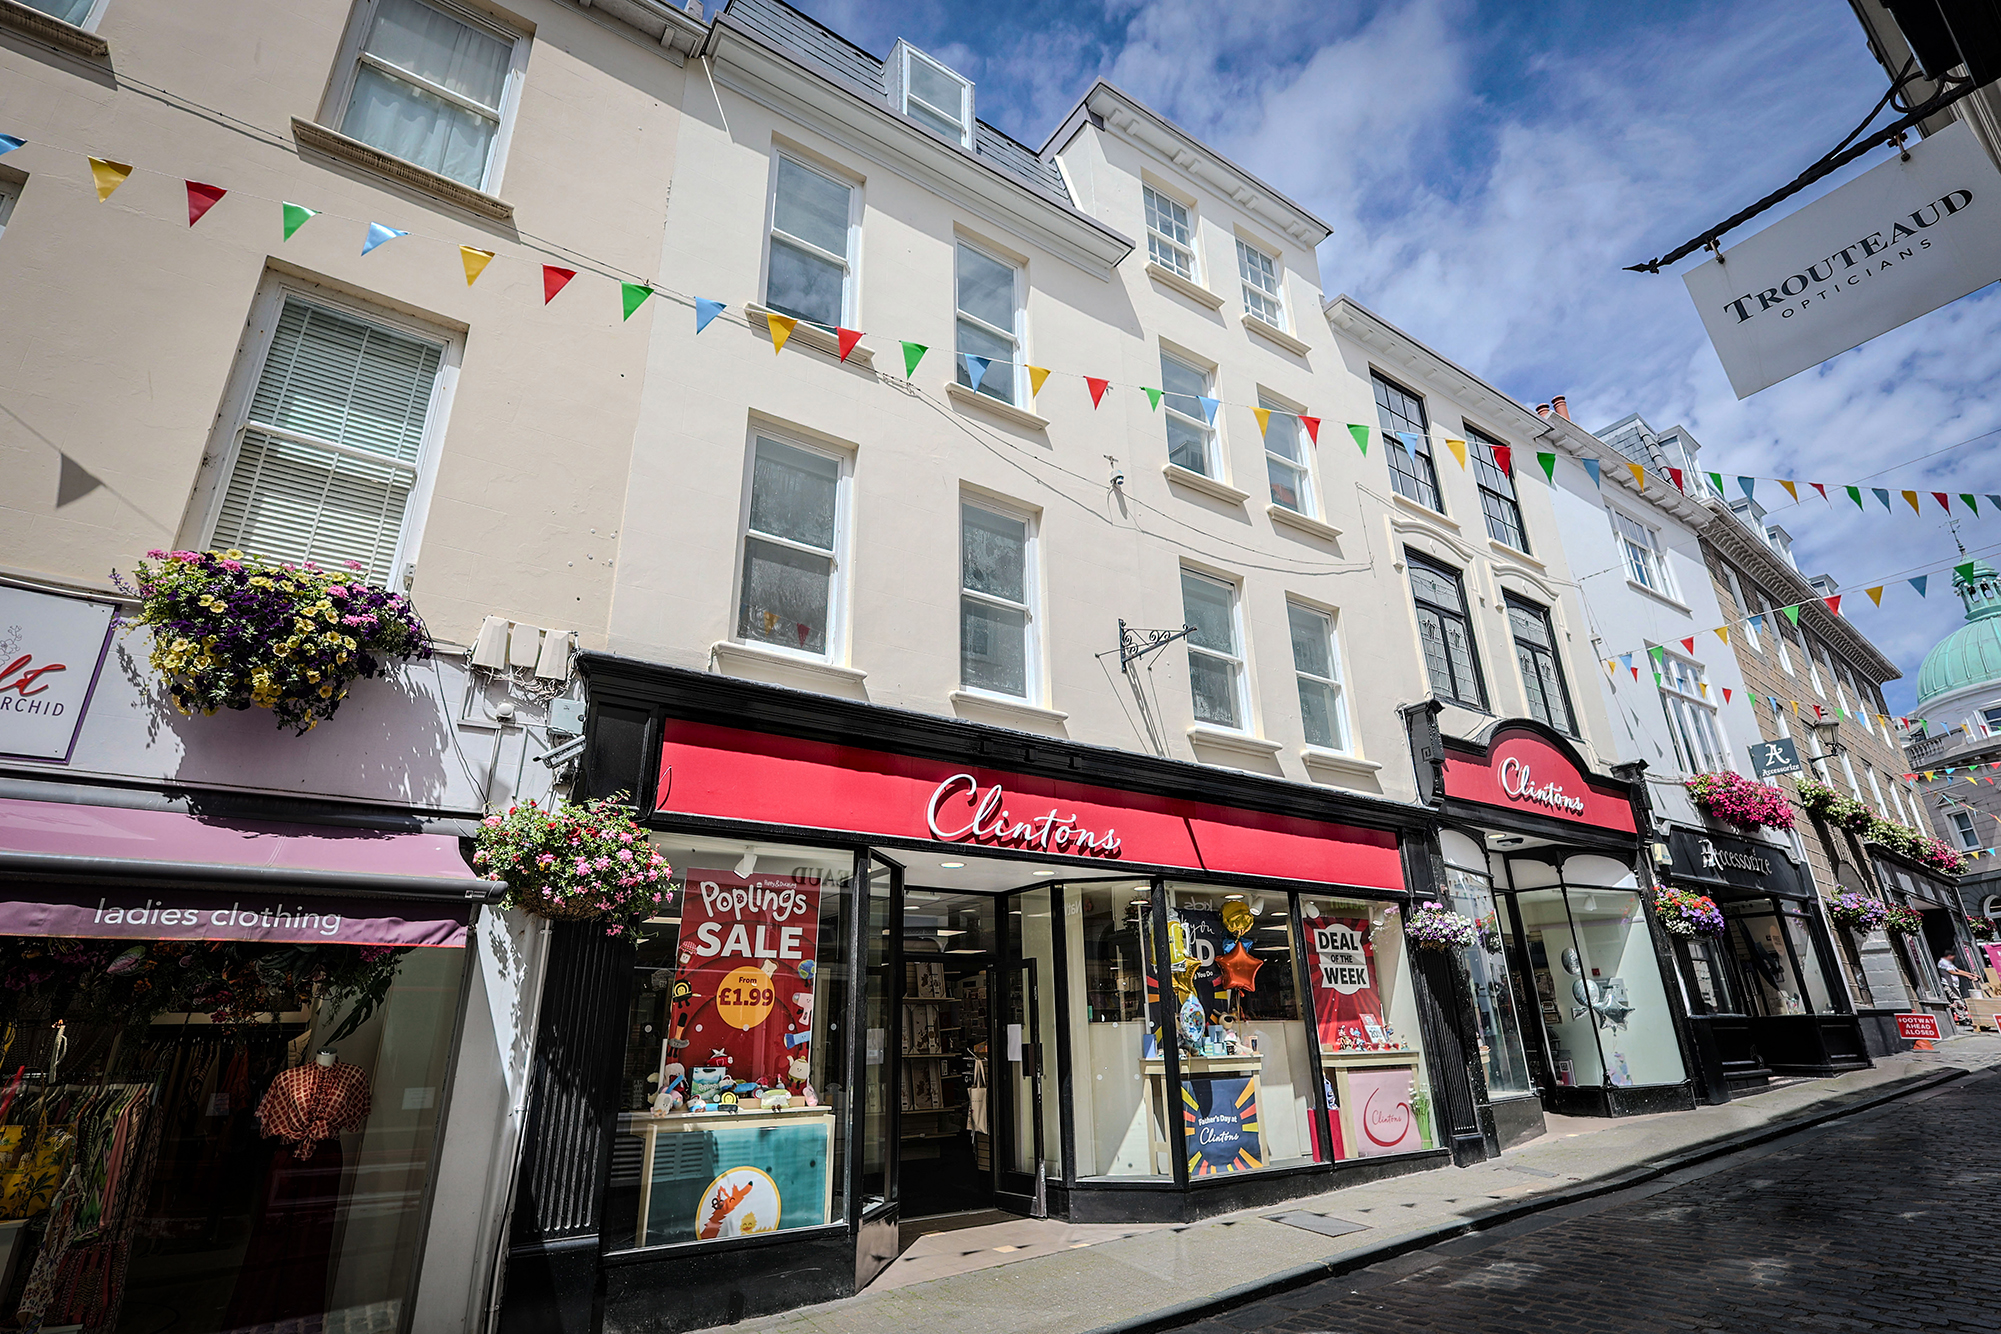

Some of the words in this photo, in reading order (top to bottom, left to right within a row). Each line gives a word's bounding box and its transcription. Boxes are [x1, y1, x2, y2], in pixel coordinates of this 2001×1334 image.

[1723, 188, 1974, 325] TROUTEAUD
[1781, 238, 1932, 319] OPTICIANS
[1500, 757, 1584, 811] Clintons
[1762, 764, 1800, 777] Accessorize
[927, 773, 1121, 850] Clintons
[1698, 838, 1773, 876] Accessorize
[700, 881, 807, 921] Poplings
[94, 898, 200, 929] ladies
[210, 906, 342, 936] clothing
[696, 922, 803, 959] SALE
[1318, 931, 1359, 951] DEAL
[1330, 954, 1339, 963] OF
[1341, 954, 1353, 963] THE
[1324, 967, 1367, 985] WEEK
[718, 988, 774, 1006] £1.99
[1219, 1114, 1231, 1124] Day
[1371, 1109, 1402, 1126] Clintons
[1200, 1126, 1240, 1145] Clintons
